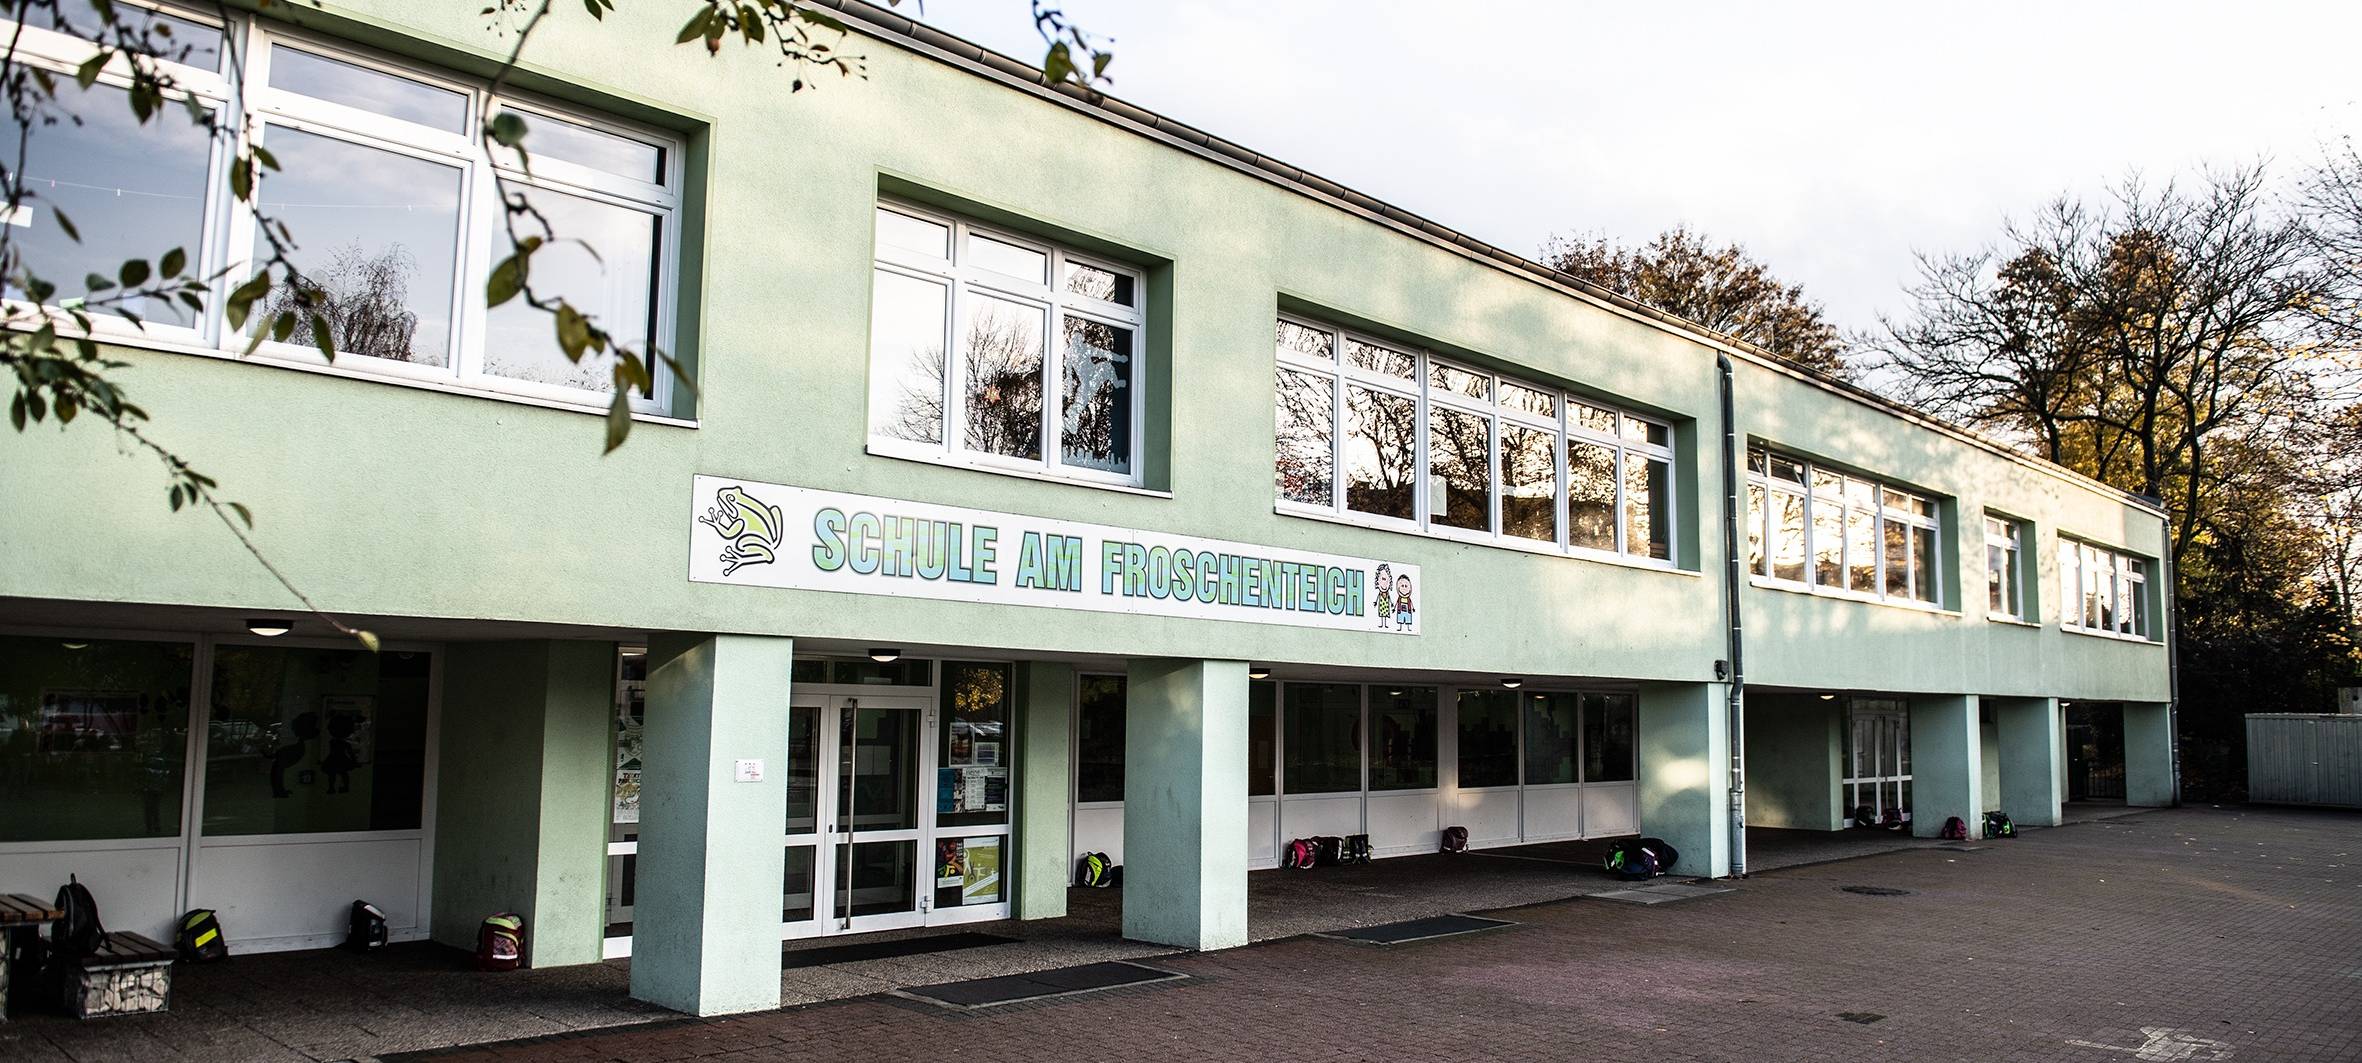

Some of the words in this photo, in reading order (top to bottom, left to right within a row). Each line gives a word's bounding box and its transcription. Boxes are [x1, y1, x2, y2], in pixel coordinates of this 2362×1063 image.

[812, 508, 998, 585] SCHULE
[1015, 531, 1082, 592] AM
[1101, 540, 1364, 617] FROSCHENTEICH
